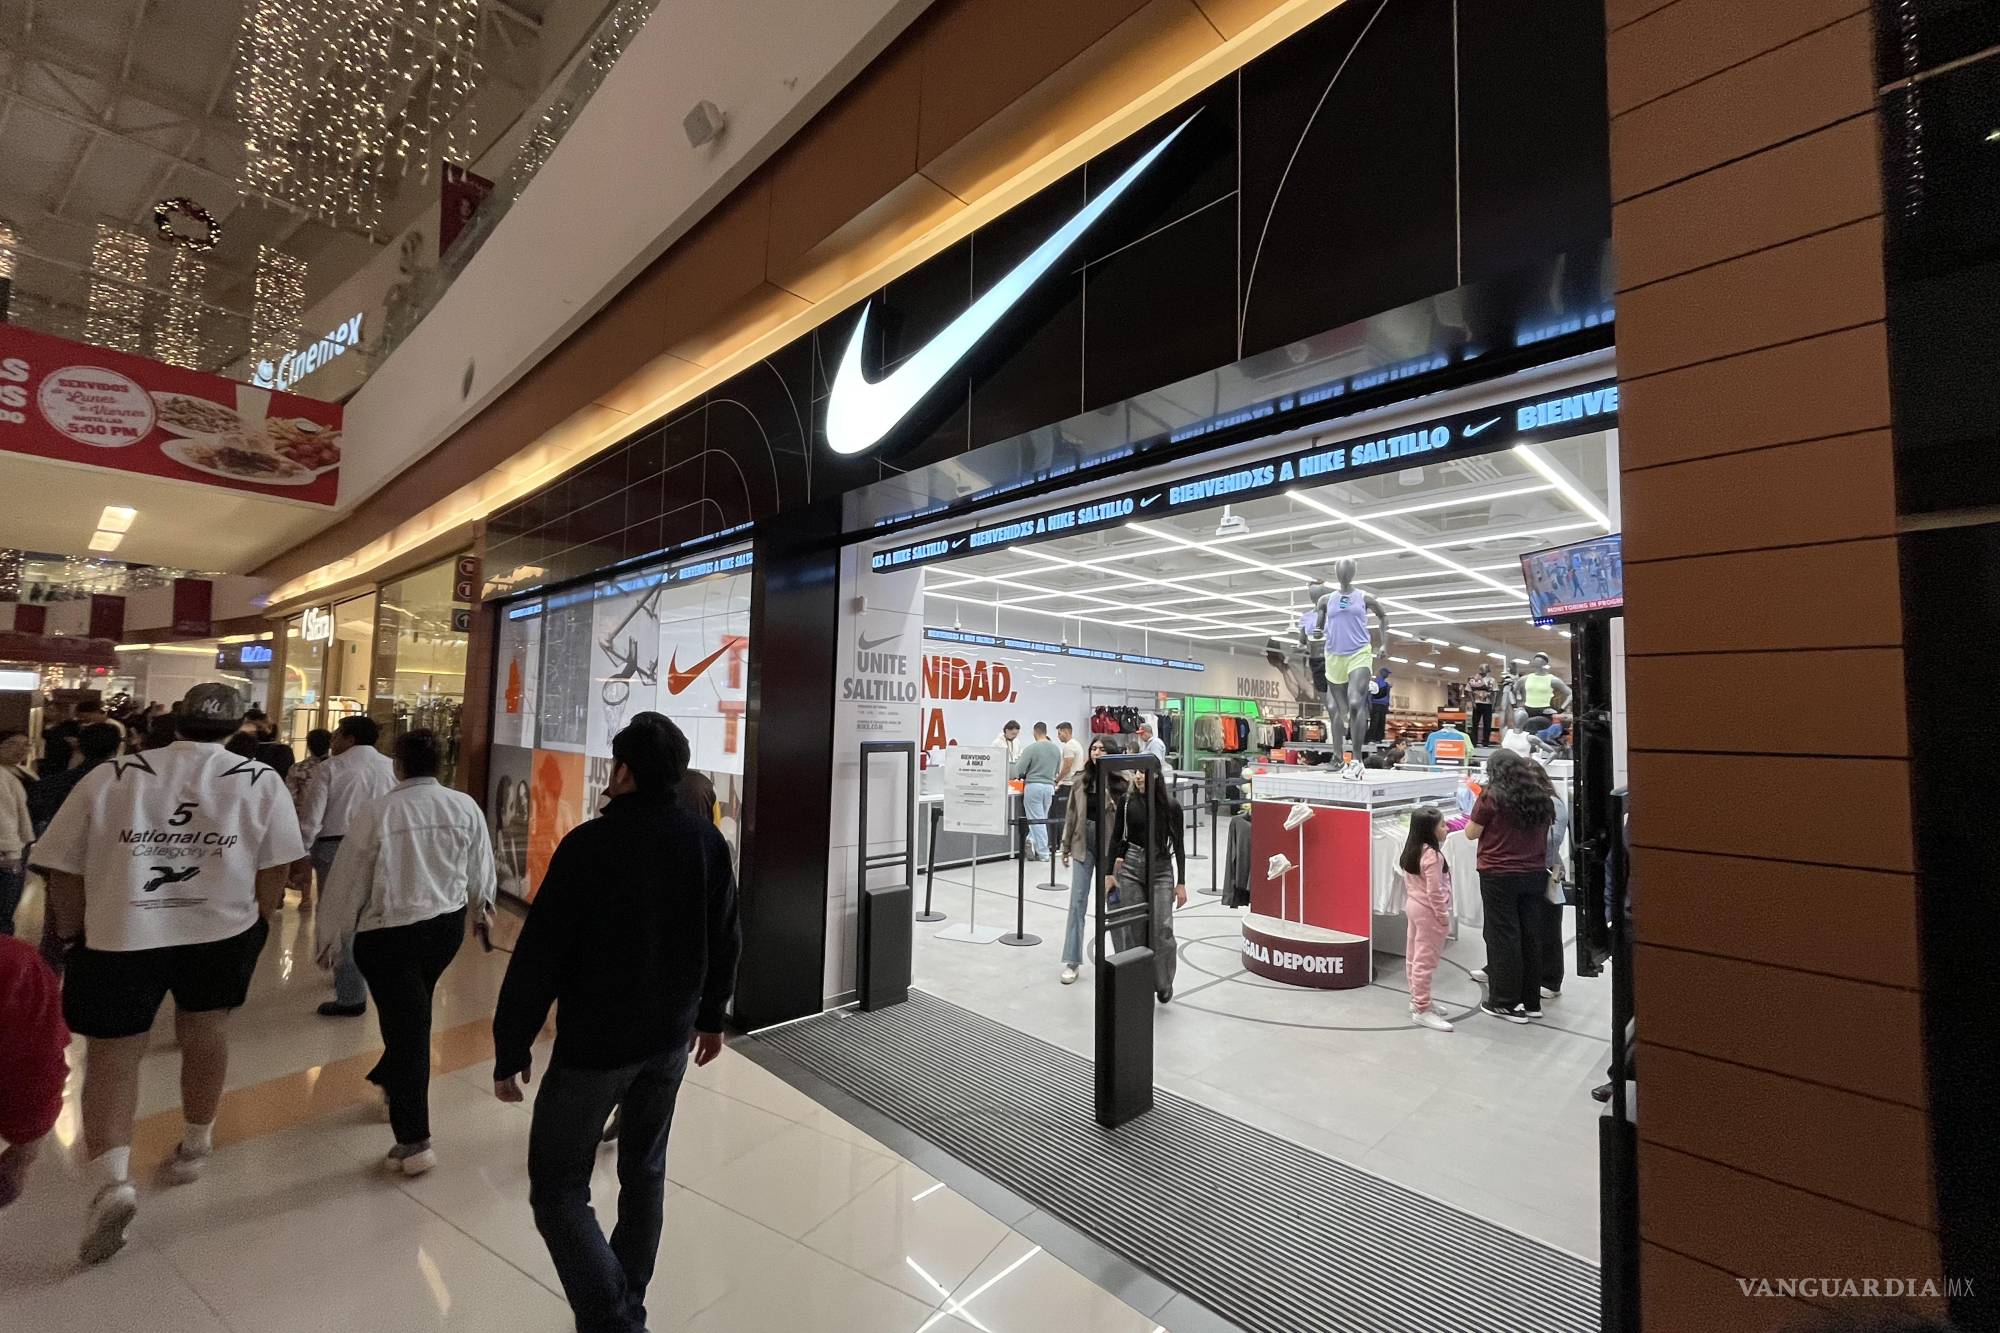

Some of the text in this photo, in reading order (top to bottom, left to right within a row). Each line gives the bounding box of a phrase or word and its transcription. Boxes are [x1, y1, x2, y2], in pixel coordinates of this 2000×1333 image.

[276, 312, 363, 391] Cinemex
[1516, 386, 1618, 432] BIENVE
[67, 423, 138, 437] 5:00 PM
[1169, 426, 1450, 505] BIENVENIDXS A NIKE SALTILLO
[1036, 518, 1046, 534] A
[1047, 510, 1076, 531] NIKE
[1078, 498, 1134, 525] SALTILLO
[857, 651, 907, 676] UNITE
[843, 677, 917, 702] SALTILLO
[1237, 676, 1280, 699] HOMBRES
[168, 802, 199, 826] 5
[118, 829, 238, 848] National Cup
[132, 844, 223, 860] Category A
[1273, 949, 1344, 975] DEPORTE
